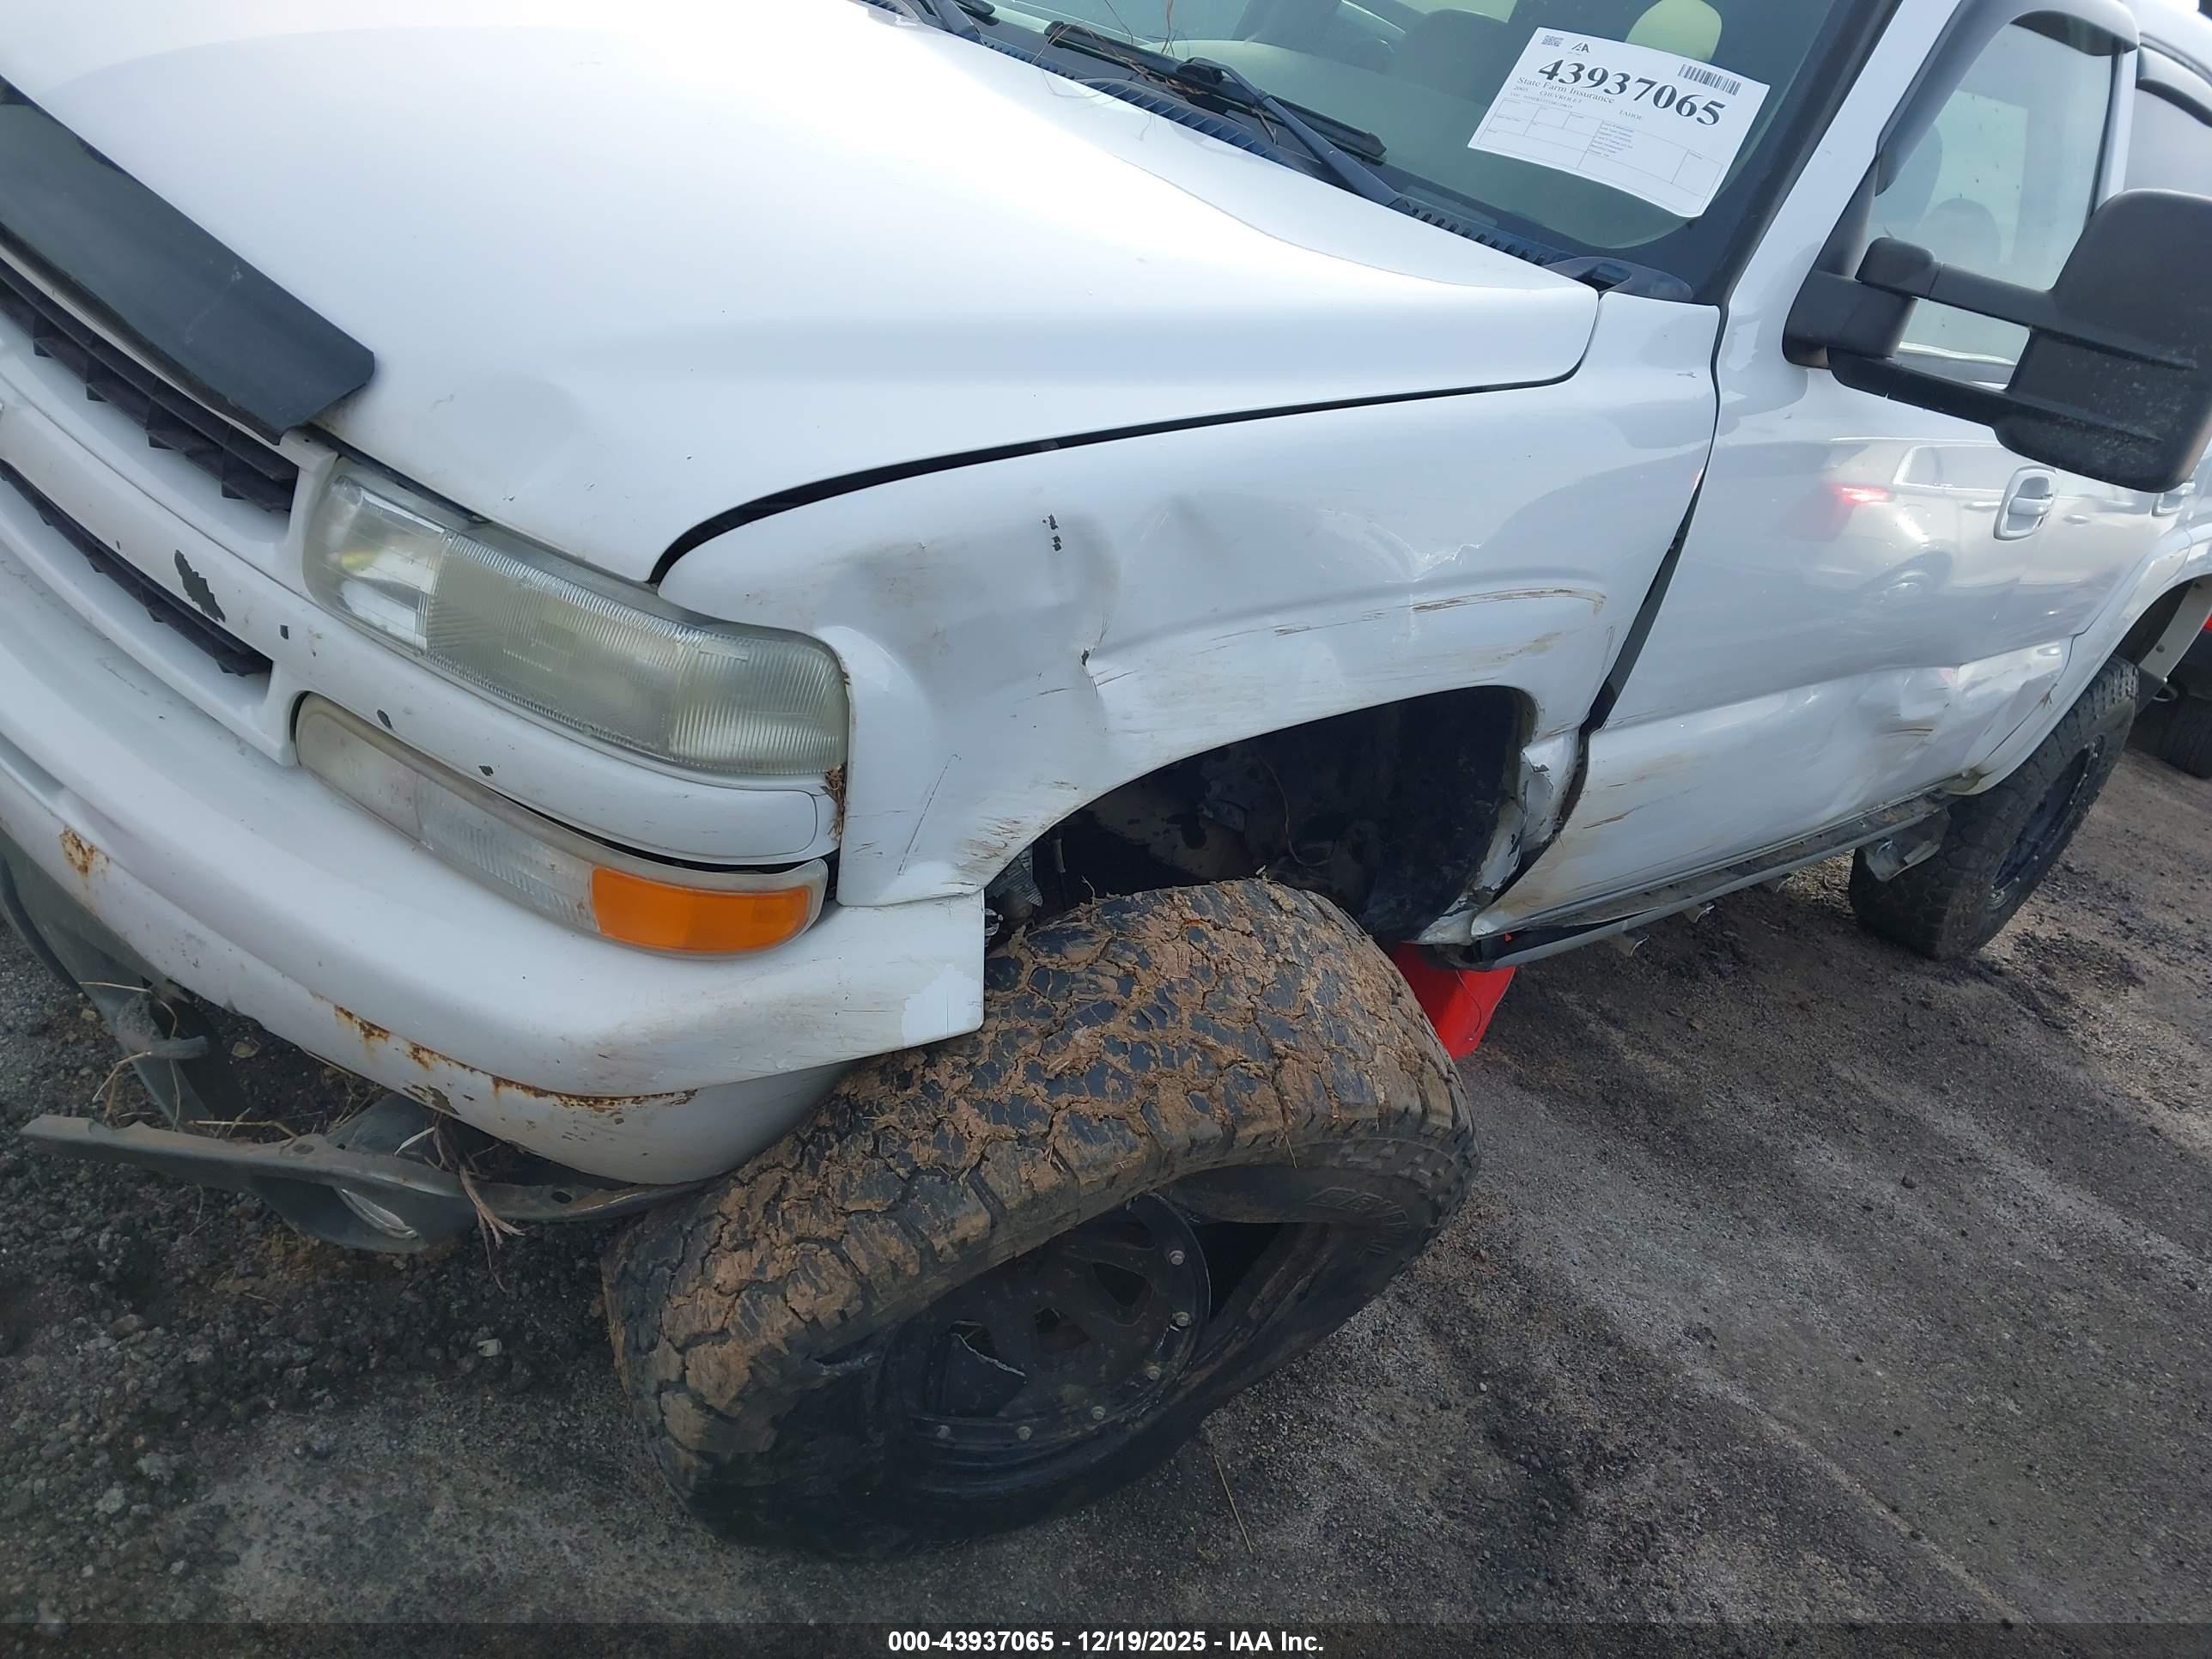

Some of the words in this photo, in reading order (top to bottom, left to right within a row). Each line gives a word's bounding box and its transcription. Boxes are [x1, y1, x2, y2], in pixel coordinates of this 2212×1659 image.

[1517, 76, 1540, 87] State
[1543, 82, 1567, 93] Farm
[1571, 88, 1614, 103] Insurance
[1539, 59, 1726, 125] 43937065
